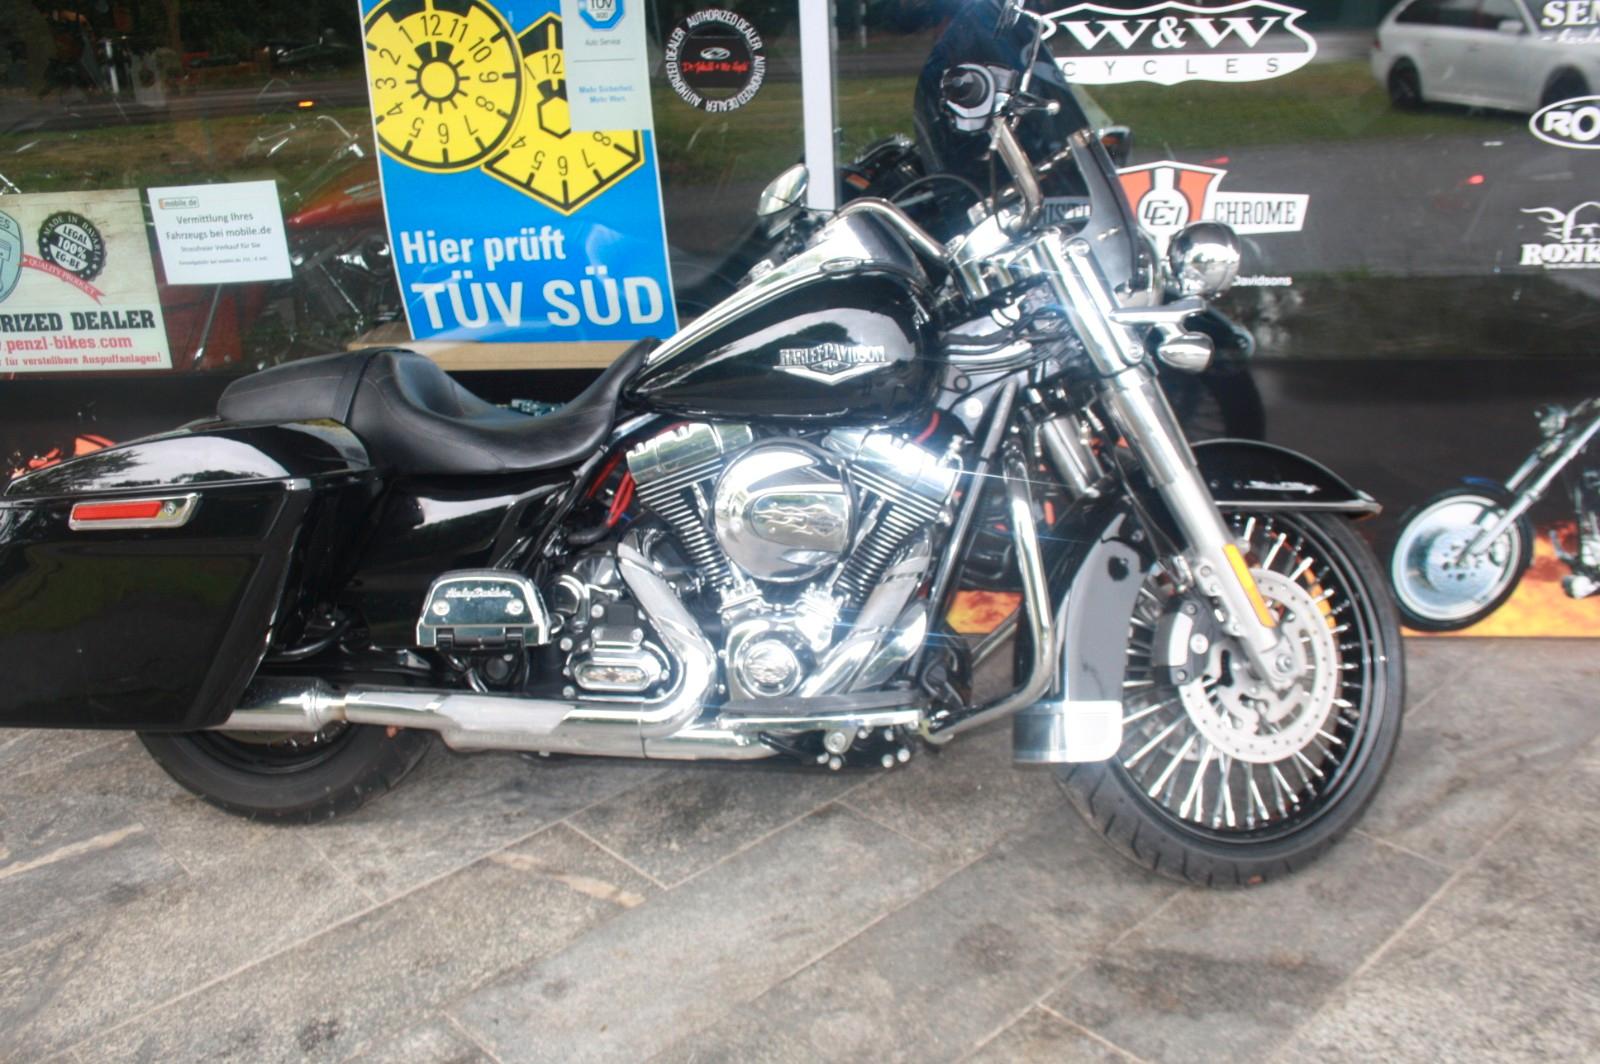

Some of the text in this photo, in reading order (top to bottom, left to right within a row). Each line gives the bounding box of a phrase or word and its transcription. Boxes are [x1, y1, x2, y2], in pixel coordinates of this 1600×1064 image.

[420, 14, 443, 37] 12
[450, 18, 468, 43] 11
[686, 9, 763, 51] AUTHORIZED DEALER
[1060, 16, 1282, 49] W&W
[468, 37, 492, 63] 10
[665, 27, 687, 61] DEALER
[379, 48, 401, 65] 2
[543, 54, 563, 75] 12
[1062, 57, 1279, 78] CYCLES
[375, 77, 397, 89] 3
[665, 61, 702, 107] AUTHORIZED
[737, 55, 766, 105] AUTHORIZED
[386, 102, 403, 116] 4
[475, 96, 495, 111] 8
[705, 97, 740, 112] DEALER
[411, 117, 424, 139] 5
[592, 131, 612, 146] 8
[511, 135, 527, 149] 4
[533, 150, 546, 171] 5
[176, 212, 254, 225] Vermittlung Ihres
[1214, 201, 1296, 225] CHROME
[43, 215, 101, 261] MADE IN BAVARIA
[63, 226, 88, 244] LEGAL
[166, 226, 272, 241] Fahrzeugs bei mobile.de
[57, 236, 87, 260] 100%
[400, 225, 566, 271] Hier prüft
[29, 258, 61, 276] QUALITY
[55, 251, 81, 269] EG-BE
[410, 265, 664, 329] TÜV SÜD
[0, 310, 156, 332] RIZED DEALER
[0, 336, 133, 354] .penzl-bikes.com
[5, 352, 162, 366] für verstellbare Auspuffanlagen!
